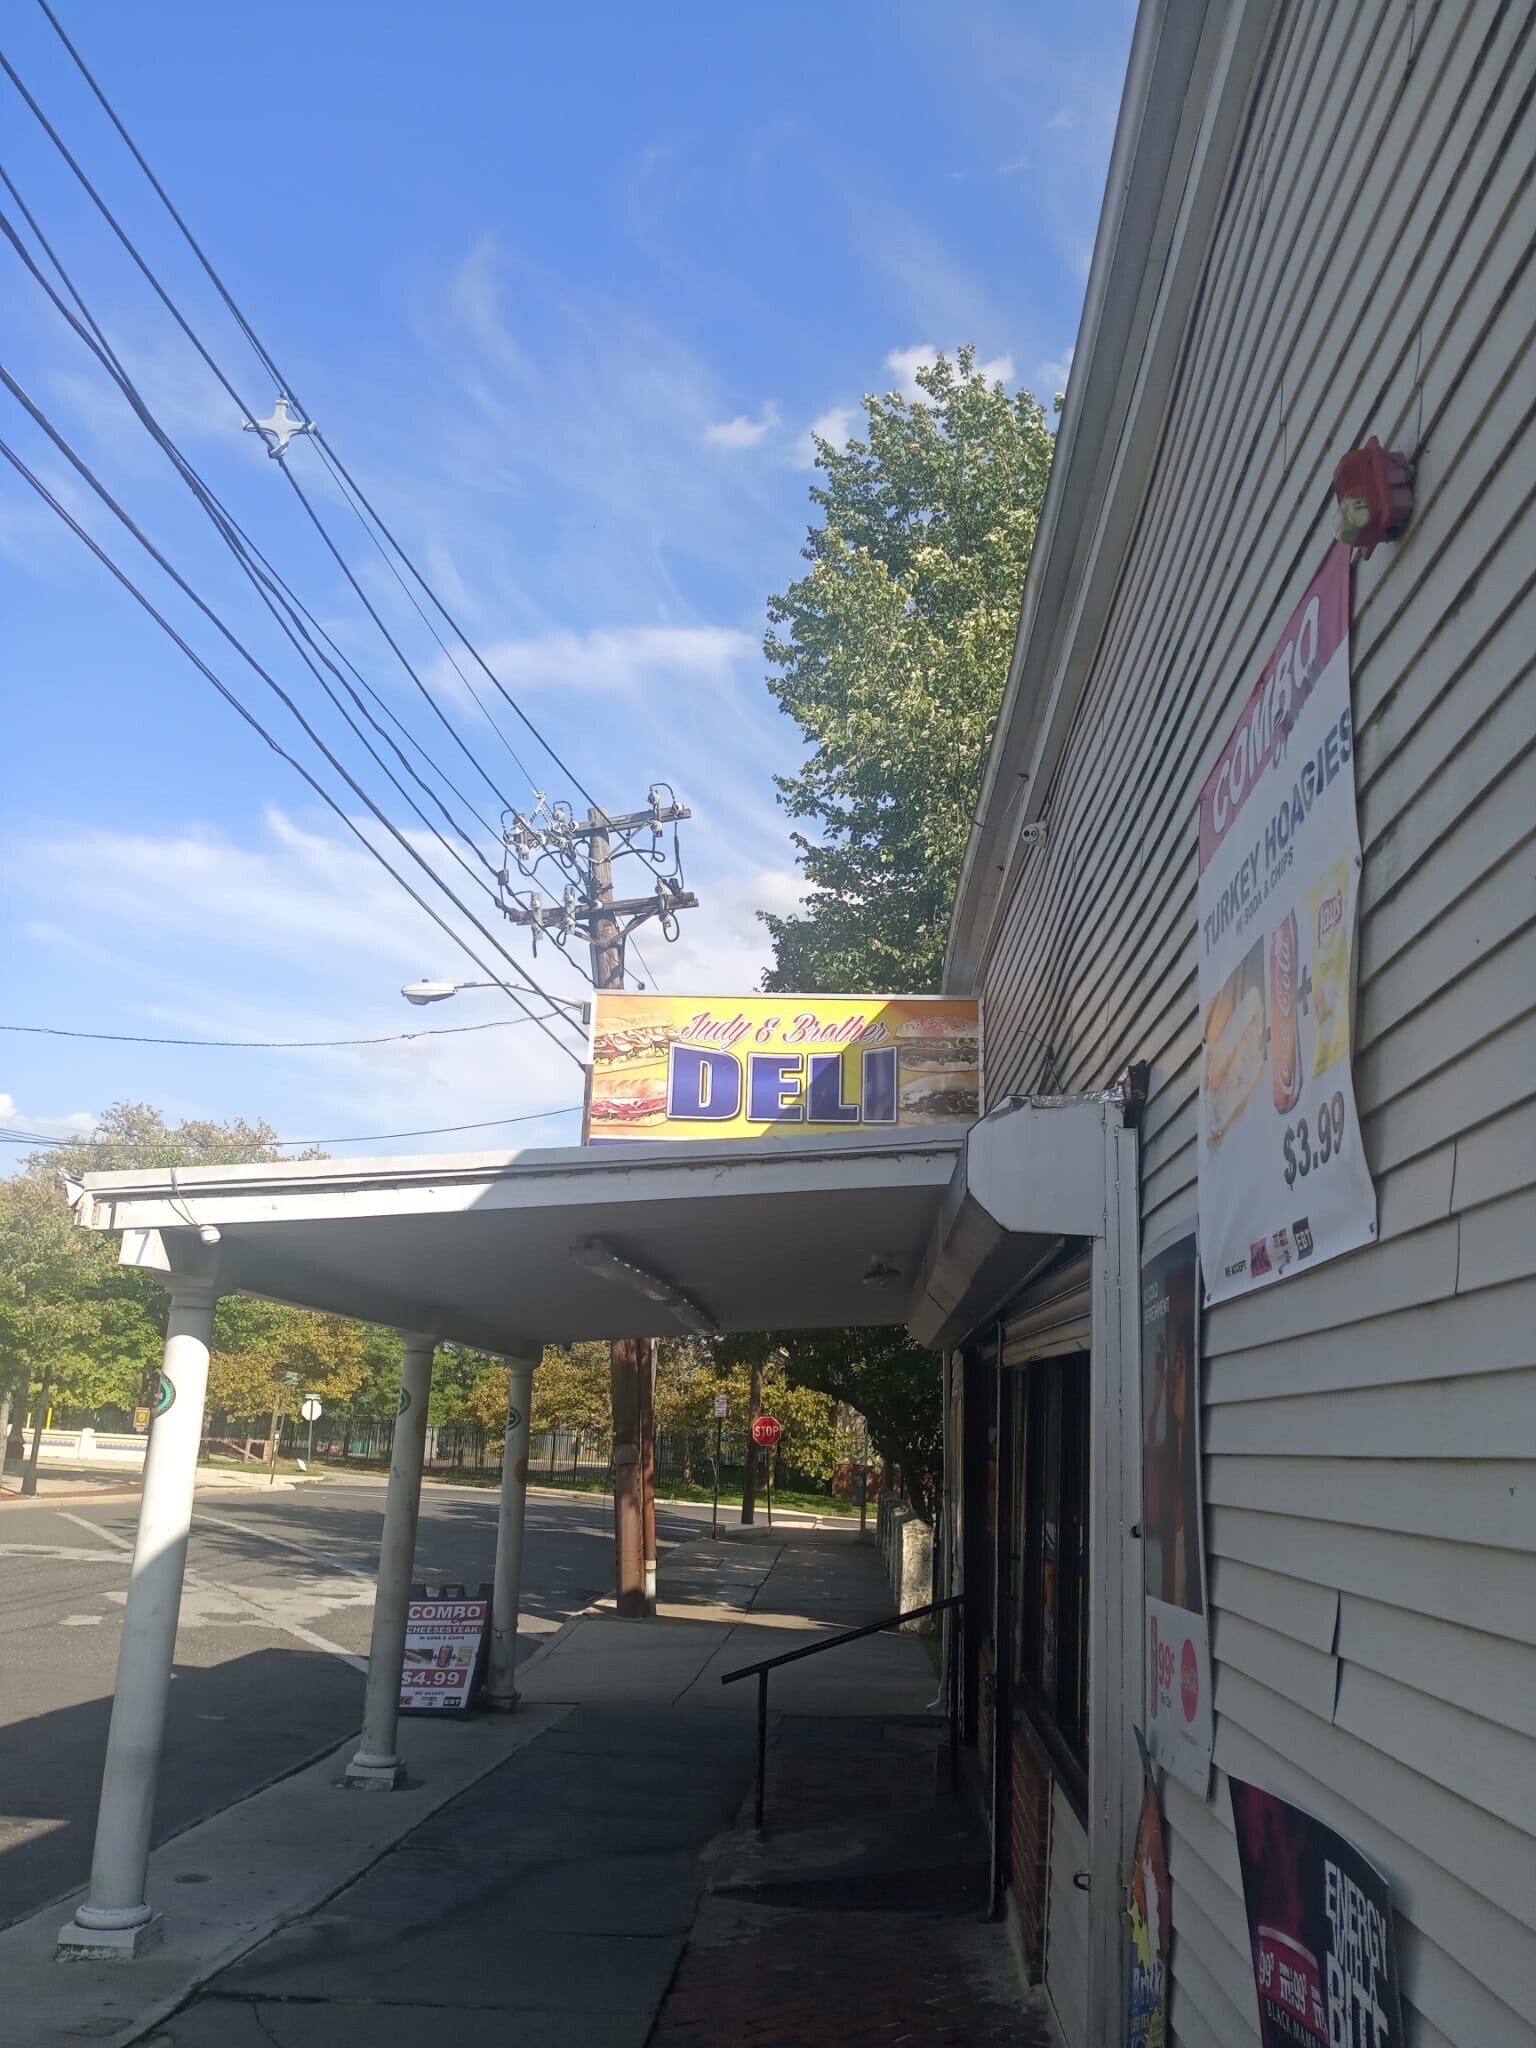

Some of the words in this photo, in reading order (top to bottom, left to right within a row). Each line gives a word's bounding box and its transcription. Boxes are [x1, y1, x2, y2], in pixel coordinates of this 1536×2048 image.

[1212, 596, 1321, 836] COMBO
[1202, 839, 1261, 955] TURKEY
[1265, 705, 1353, 866] HOAGIES
[1263, 879, 1270, 899] &
[1270, 844, 1294, 889] CHIPS
[679, 1012, 753, 1050] Judy
[755, 1017, 780, 1044] &
[782, 1013, 891, 1044] Brother
[667, 1041, 898, 1125] DELI
[1283, 1090, 1345, 1191] $3.99
[1295, 1229, 1312, 1251] EBT
[754, 1426, 779, 1437] STOP
[408, 1606, 481, 1619] COMBO
[401, 1671, 460, 1686] $4.99
[1324, 1858, 1389, 1982] ENERGY
[1332, 1917, 1364, 1988] WITH
[1369, 1956, 1378, 2007] A
[1266, 1999, 1291, 2033] BLACK
